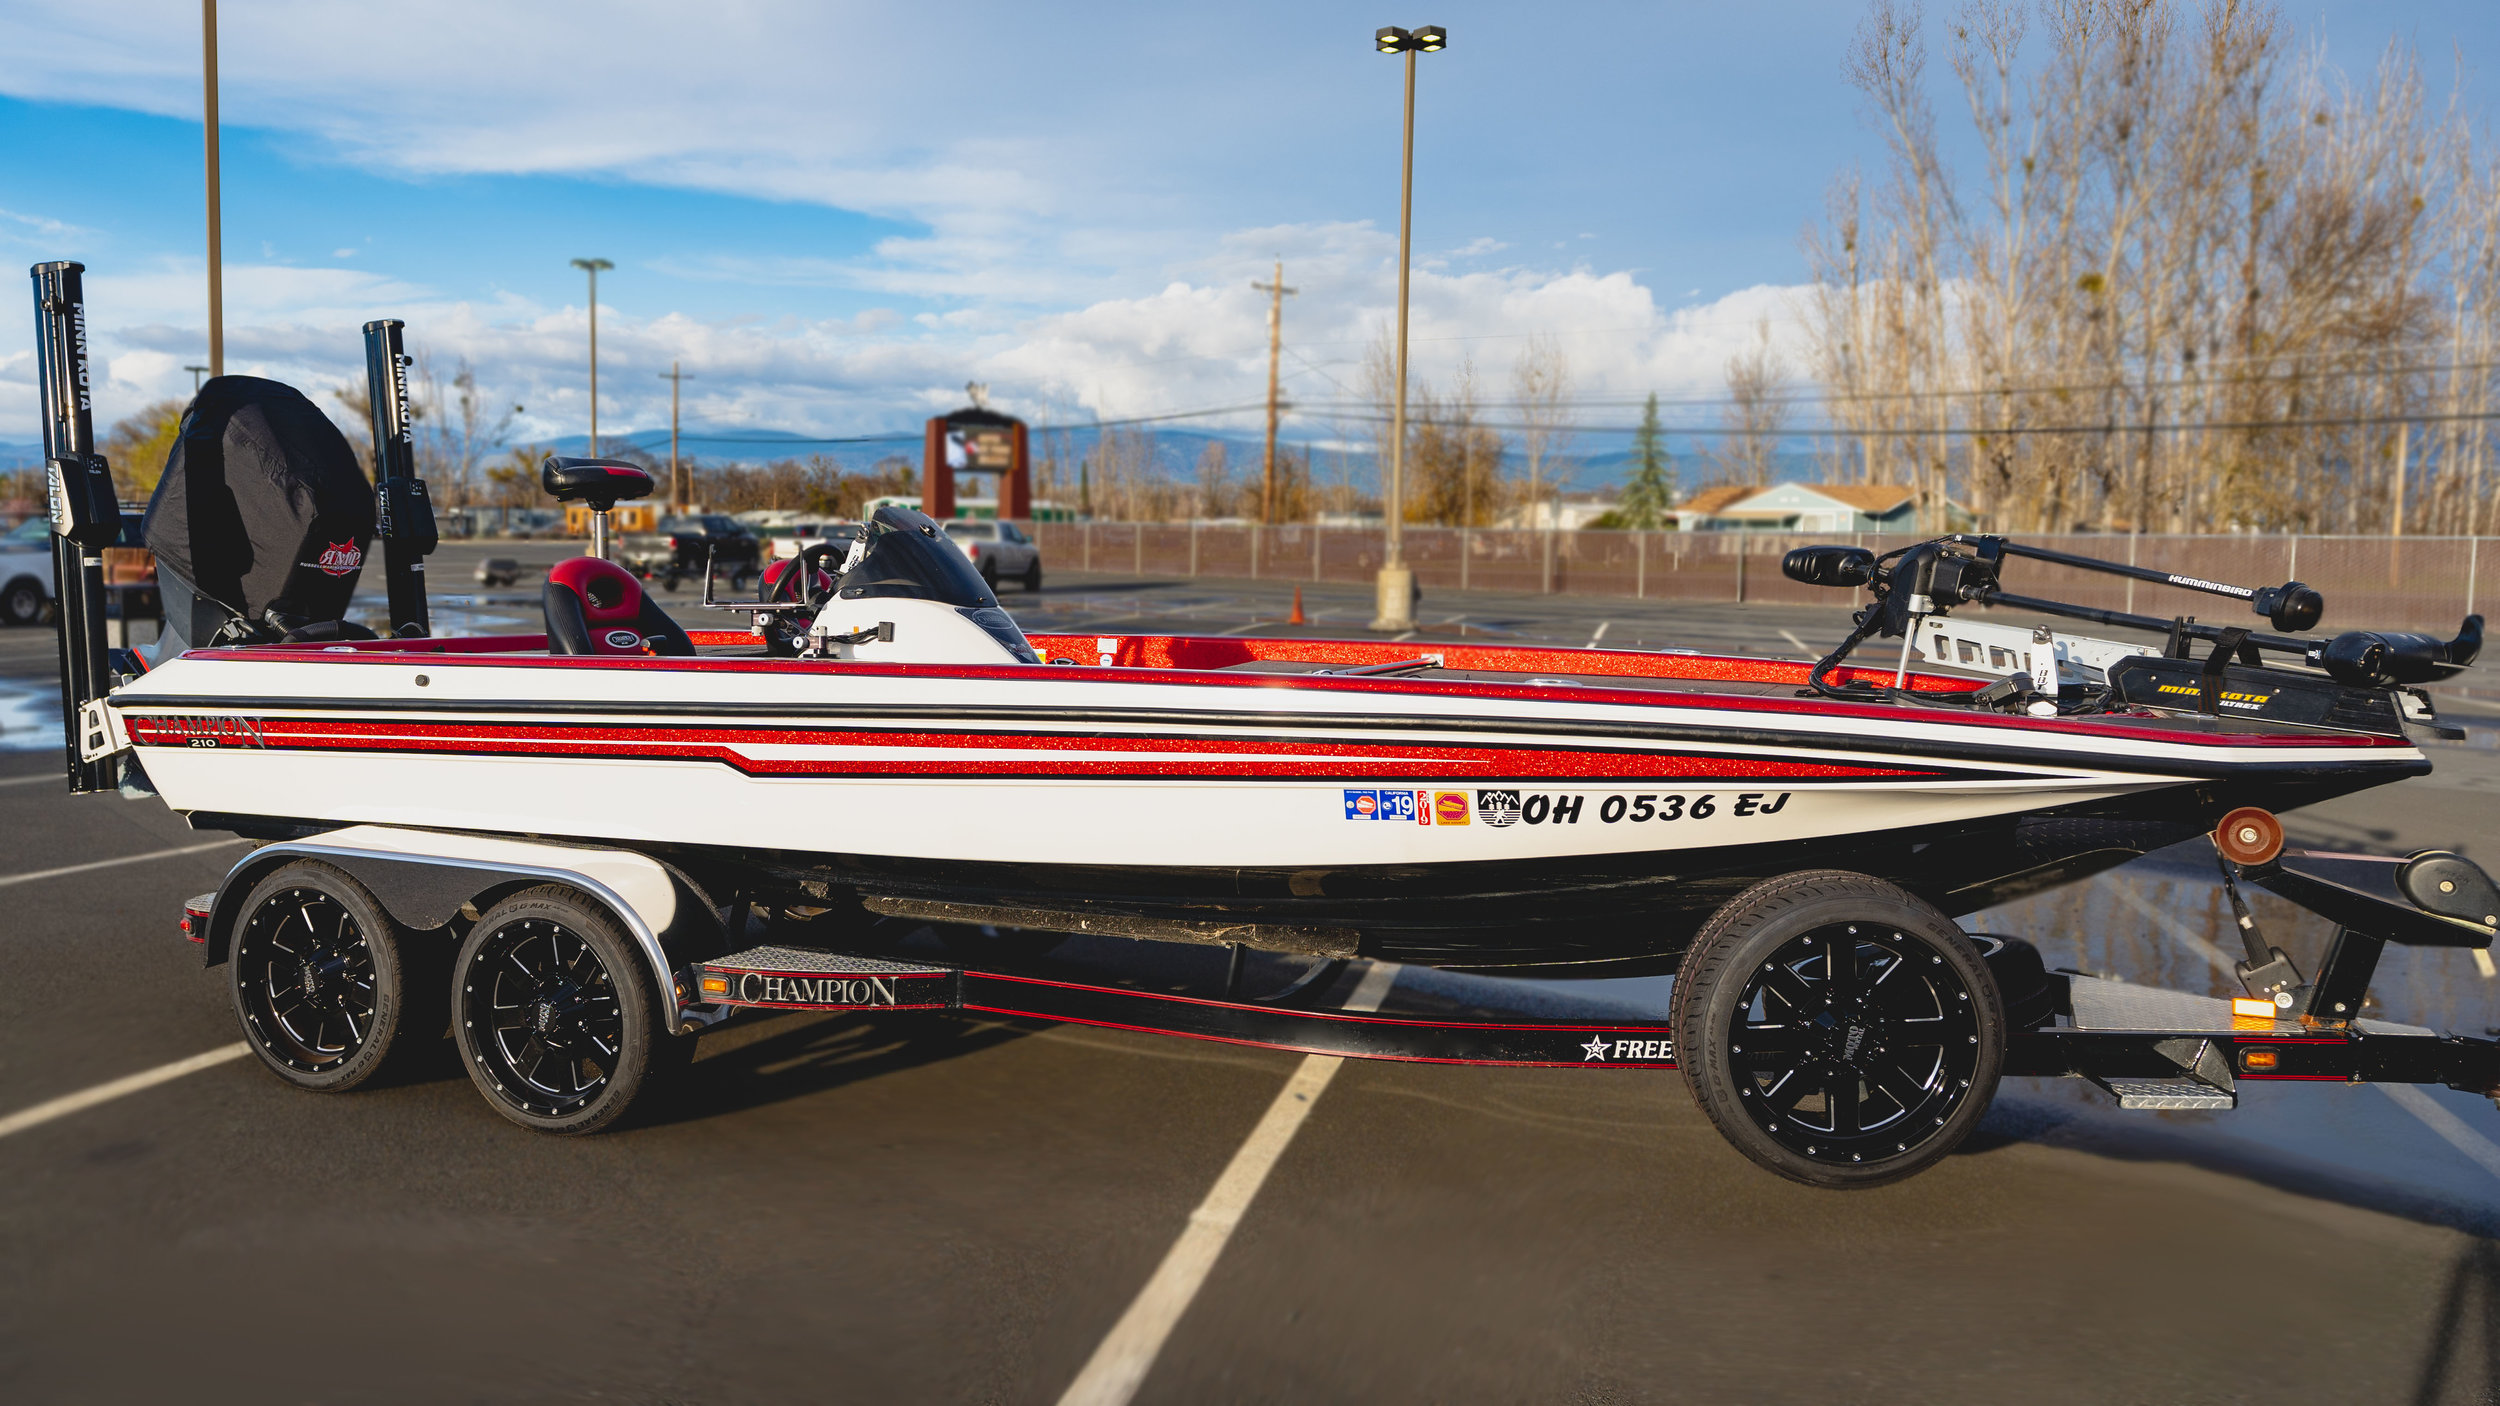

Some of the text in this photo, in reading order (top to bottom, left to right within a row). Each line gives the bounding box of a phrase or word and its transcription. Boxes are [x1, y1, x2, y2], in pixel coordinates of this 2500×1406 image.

[72, 302, 91, 411] MINN KOTA
[395, 353, 412, 443] MINN KOTA
[48, 463, 63, 525] TALON
[2168, 574, 2254, 597] HUMMINBIRD
[2158, 684, 2201, 696] MIN
[134, 714, 266, 750] CHAMPION
[191, 739, 216, 748] 210
[1391, 796, 1414, 816] 19
[1419, 792, 1429, 825] 2019
[1522, 792, 1792, 825] OH 0536 EJ
[740, 972, 900, 1006] CHAMPION
[1612, 1039, 1675, 1059] FREE
